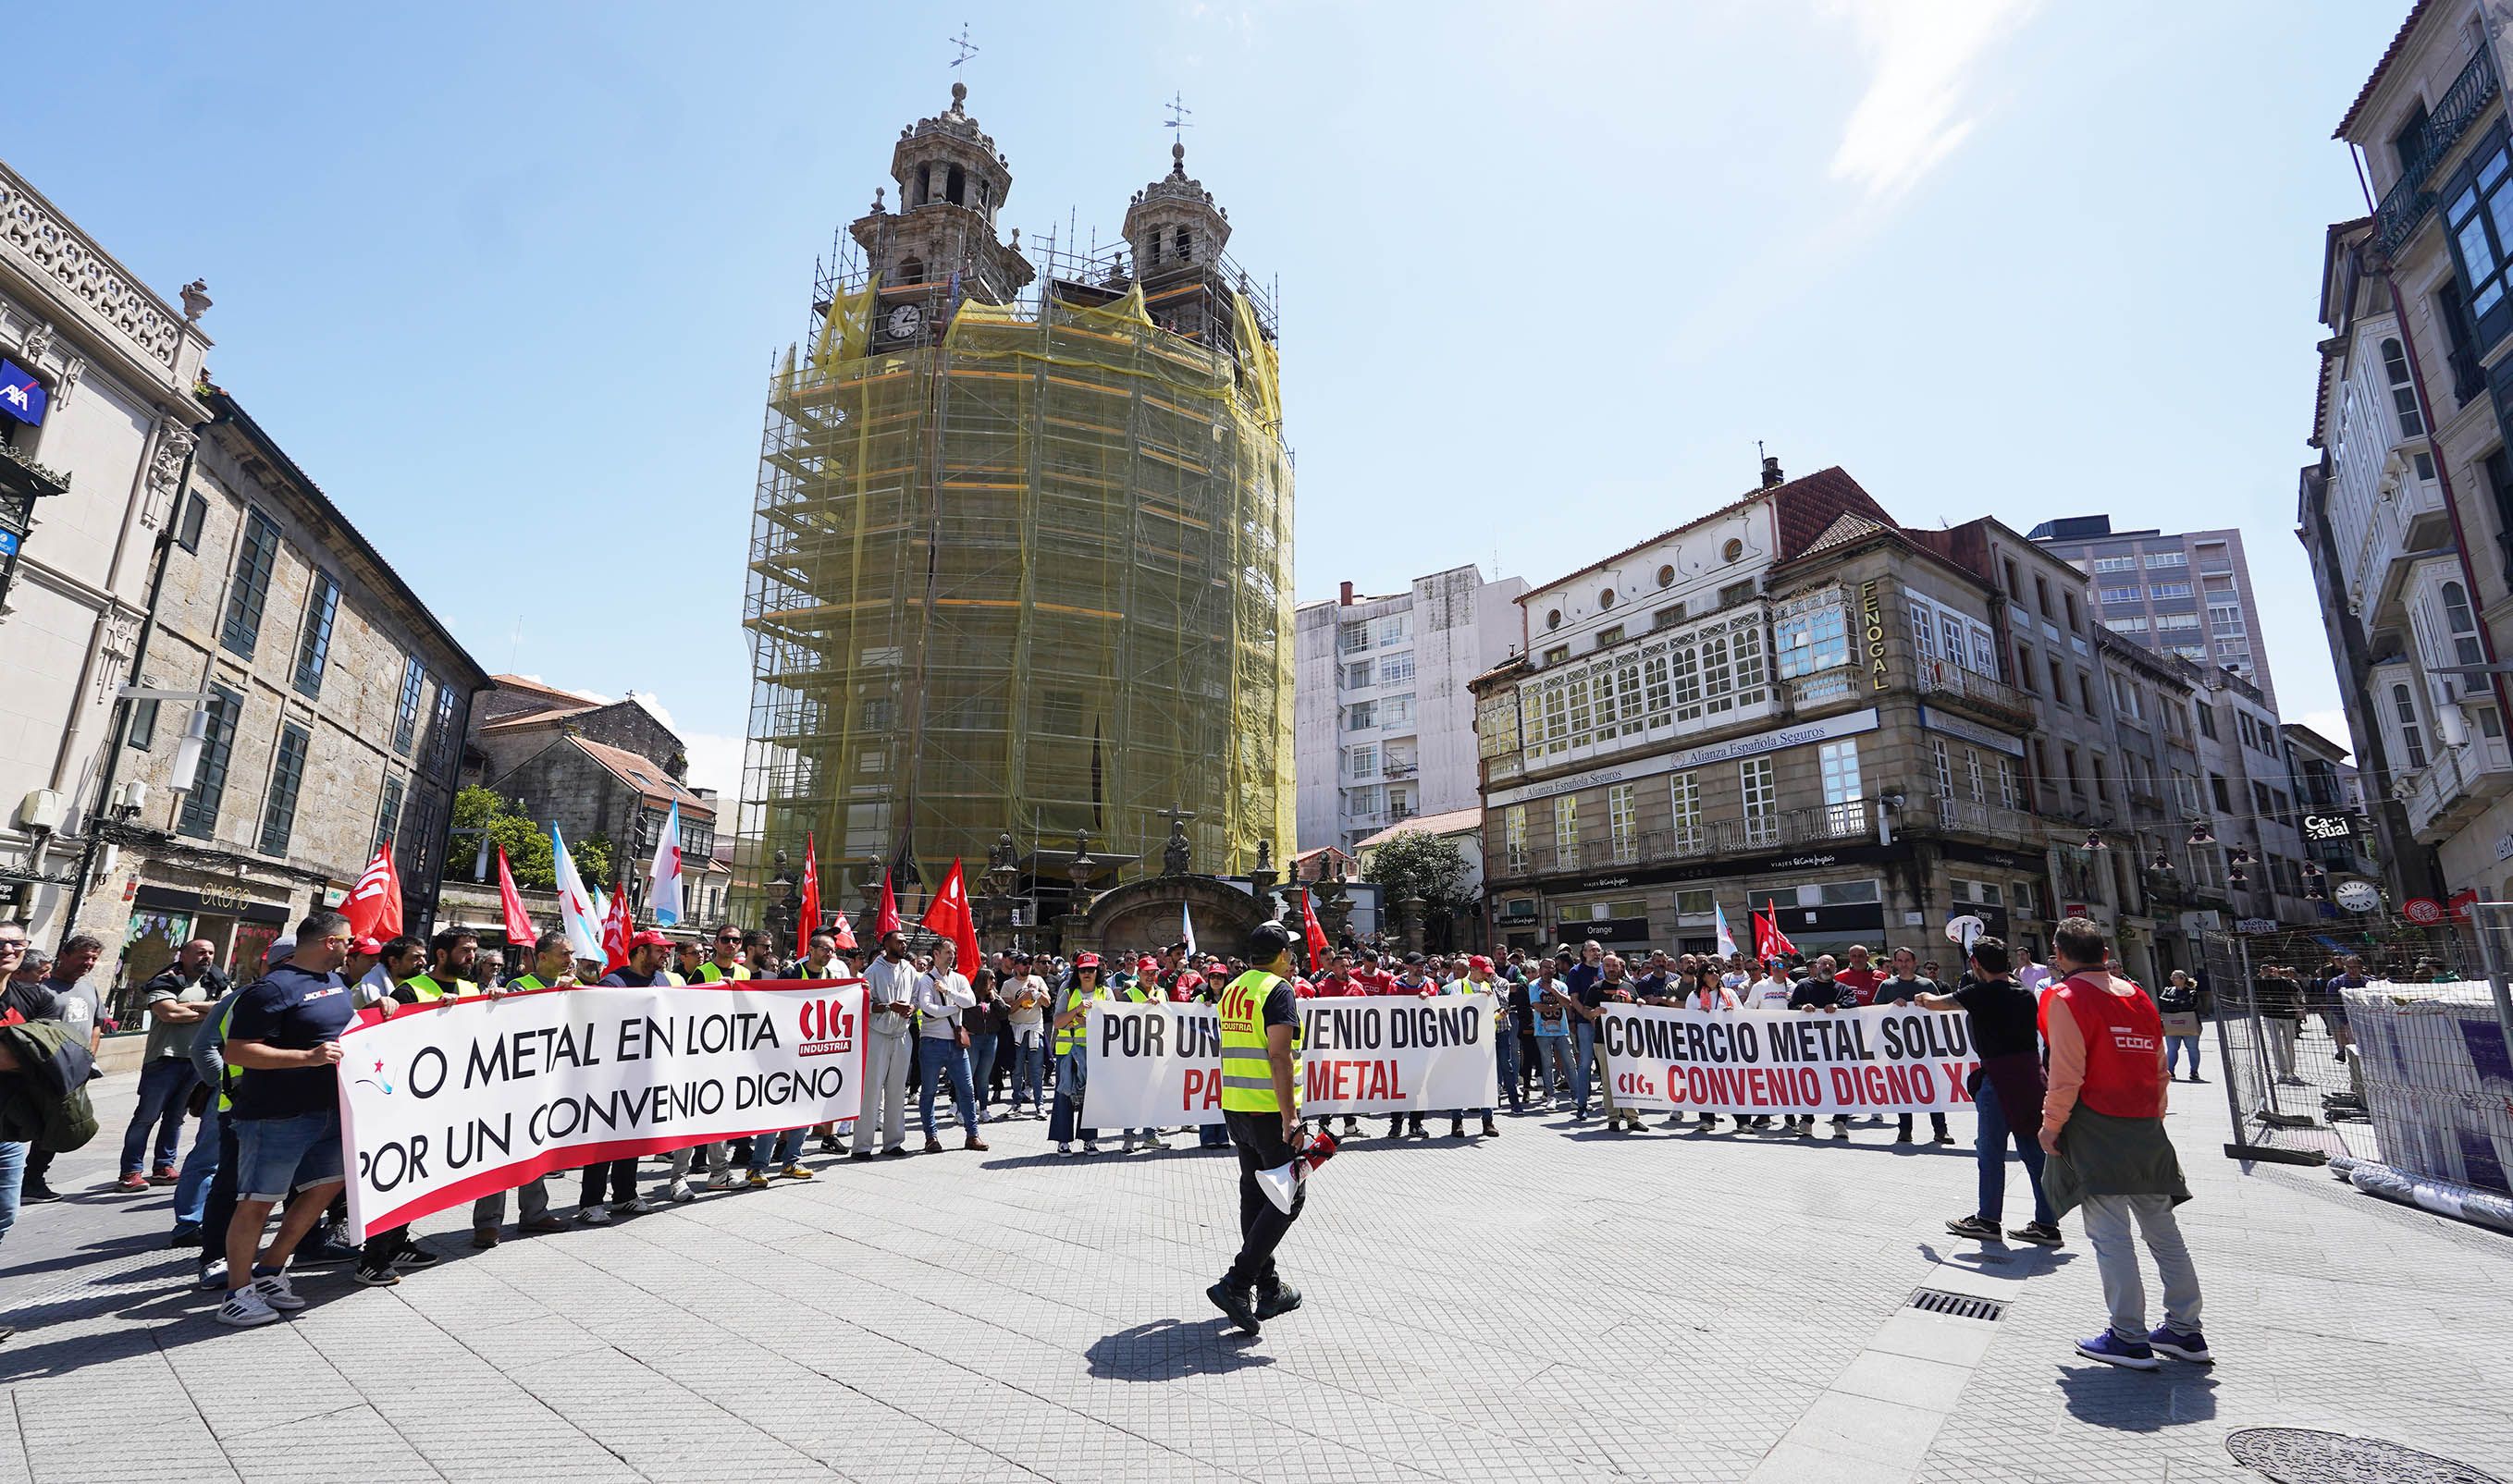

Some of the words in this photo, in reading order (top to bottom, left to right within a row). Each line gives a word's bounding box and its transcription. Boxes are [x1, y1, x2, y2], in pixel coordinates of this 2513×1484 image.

[0, 382, 37, 411] AXA
[1862, 581, 1889, 691] FENOGAL
[1690, 748, 1726, 763] Alianza
[1730, 736, 1777, 756] Española
[1780, 726, 1826, 745] Seguros
[1526, 785, 1553, 797] Alianza
[1555, 777, 1589, 792] Española
[1590, 768, 1622, 783] Seguros
[2317, 820, 2350, 839] sual
[1587, 926, 1613, 935] Orange
[1975, 909, 1993, 923] Orange
[1363, 984, 1381, 993] COO
[799, 1000, 854, 1040] CIG
[1103, 1014, 1165, 1058] POR
[1176, 1015, 1221, 1059] UN
[1391, 1005, 1480, 1049] DIGNO
[1222, 1023, 1252, 1032] DUSTRIA
[800, 1042, 850, 1055] INDUSTRIA
[1605, 1016, 1758, 1063] COMERCIO
[1768, 1018, 1875, 1063] METAL
[1882, 1013, 1980, 1061] SOLU
[409, 1046, 448, 1099] O
[463, 1022, 600, 1089] METAL
[617, 1015, 674, 1062] EN
[686, 1011, 780, 1055] LOITA
[1307, 1060, 1407, 1102] METAL
[1618, 1073, 1654, 1095] CIG
[1668, 1064, 1822, 1108] CONVENIO
[1831, 1063, 1936, 1107] DIGNO
[1940, 1061, 1981, 1103] X
[447, 1112, 511, 1169] UN
[528, 1078, 724, 1147] CONVENIO
[736, 1066, 844, 1110] DIGNO
